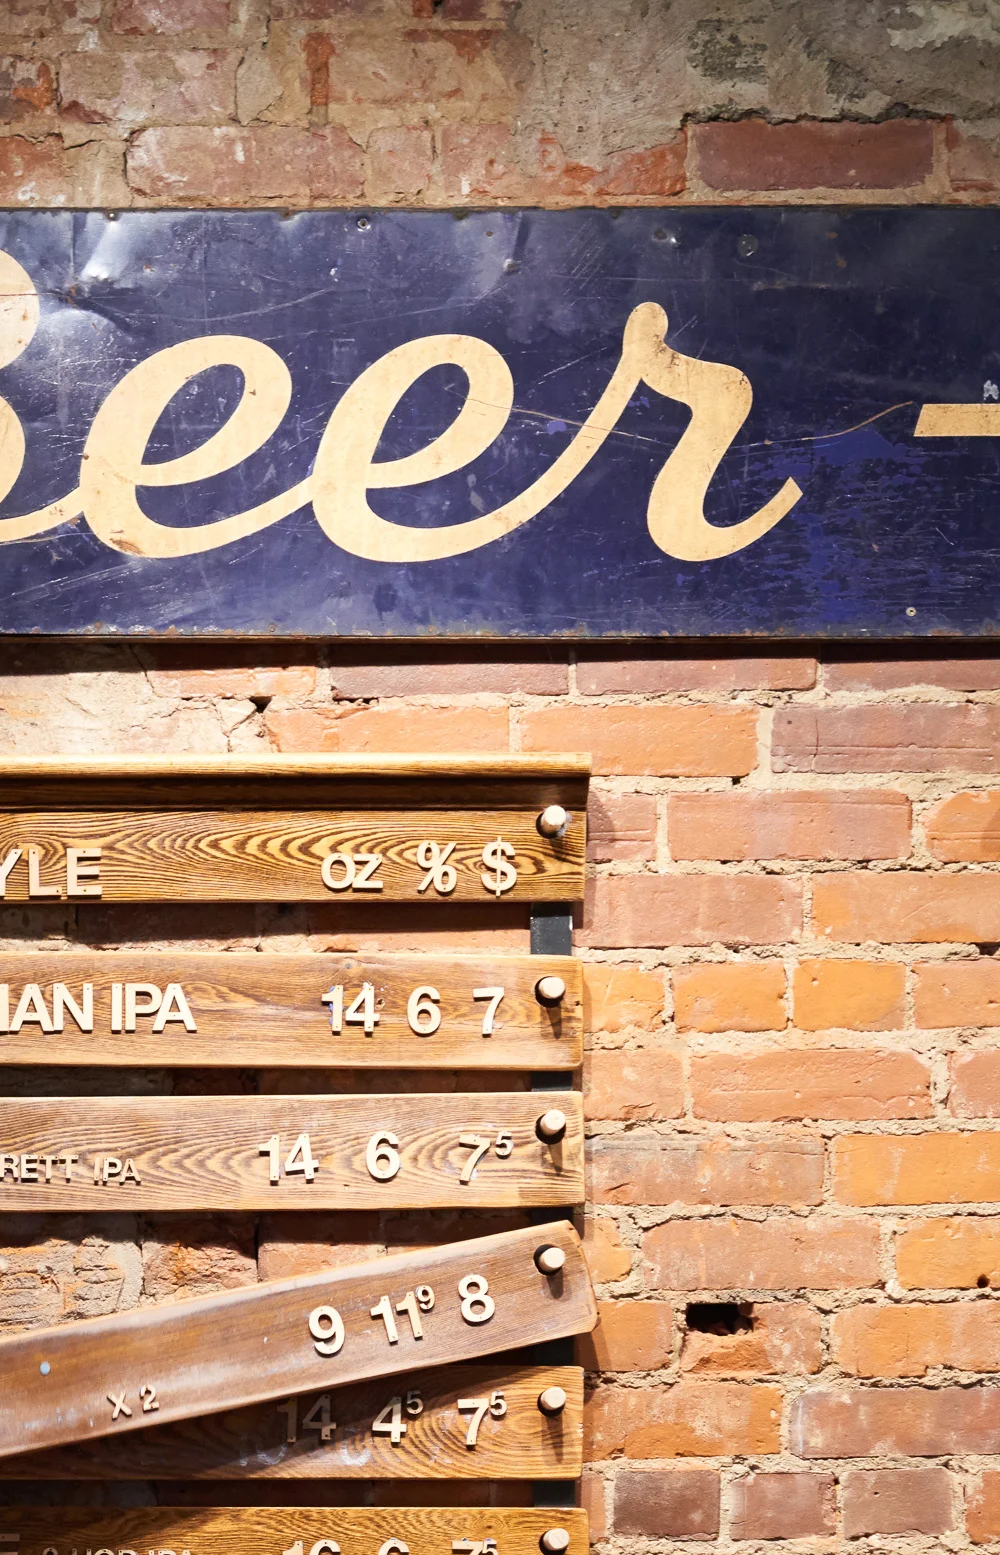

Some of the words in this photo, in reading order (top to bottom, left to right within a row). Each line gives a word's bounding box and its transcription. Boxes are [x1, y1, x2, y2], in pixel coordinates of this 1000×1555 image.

[417, 841, 457, 894] %
[480, 836, 518, 898] $
[110, 982, 198, 1034] IPA
[321, 982, 381, 1036] 14
[407, 986, 441, 1035] 6
[472, 987, 505, 1036] 7
[93, 1156, 142, 1185] IPA
[258, 1132, 320, 1185] 14
[365, 1131, 400, 1182] 6
[308, 1305, 345, 1355] 9
[458, 1274, 496, 1324] 8
[139, 1384, 161, 1413] 2
[276, 1394, 337, 1443] 14
